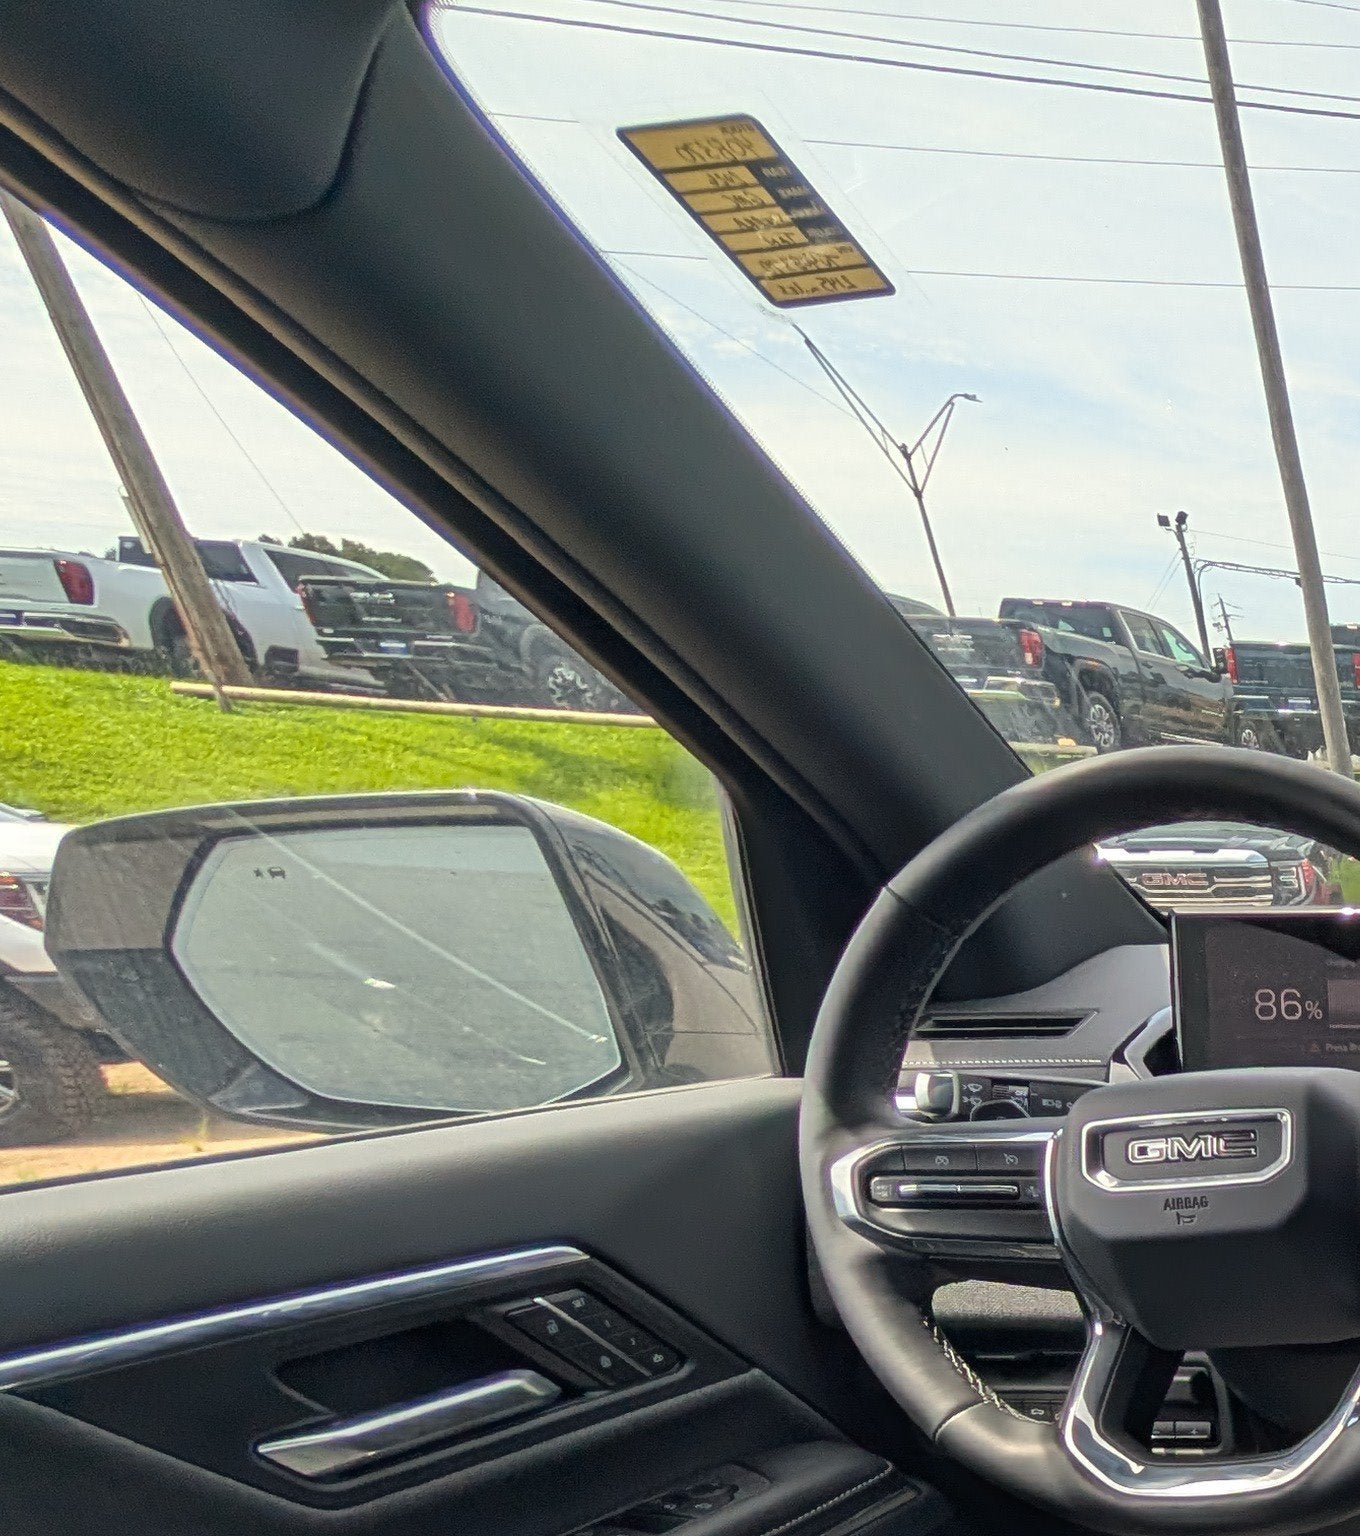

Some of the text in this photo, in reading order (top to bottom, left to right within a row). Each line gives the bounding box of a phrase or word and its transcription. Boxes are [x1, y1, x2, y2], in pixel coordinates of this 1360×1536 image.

[1140, 872, 1208, 887] GMC
[1254, 988, 1323, 1021] 86%
[1126, 1129, 1258, 1165] GMC
[1162, 1195, 1209, 1211] AIRBAG
